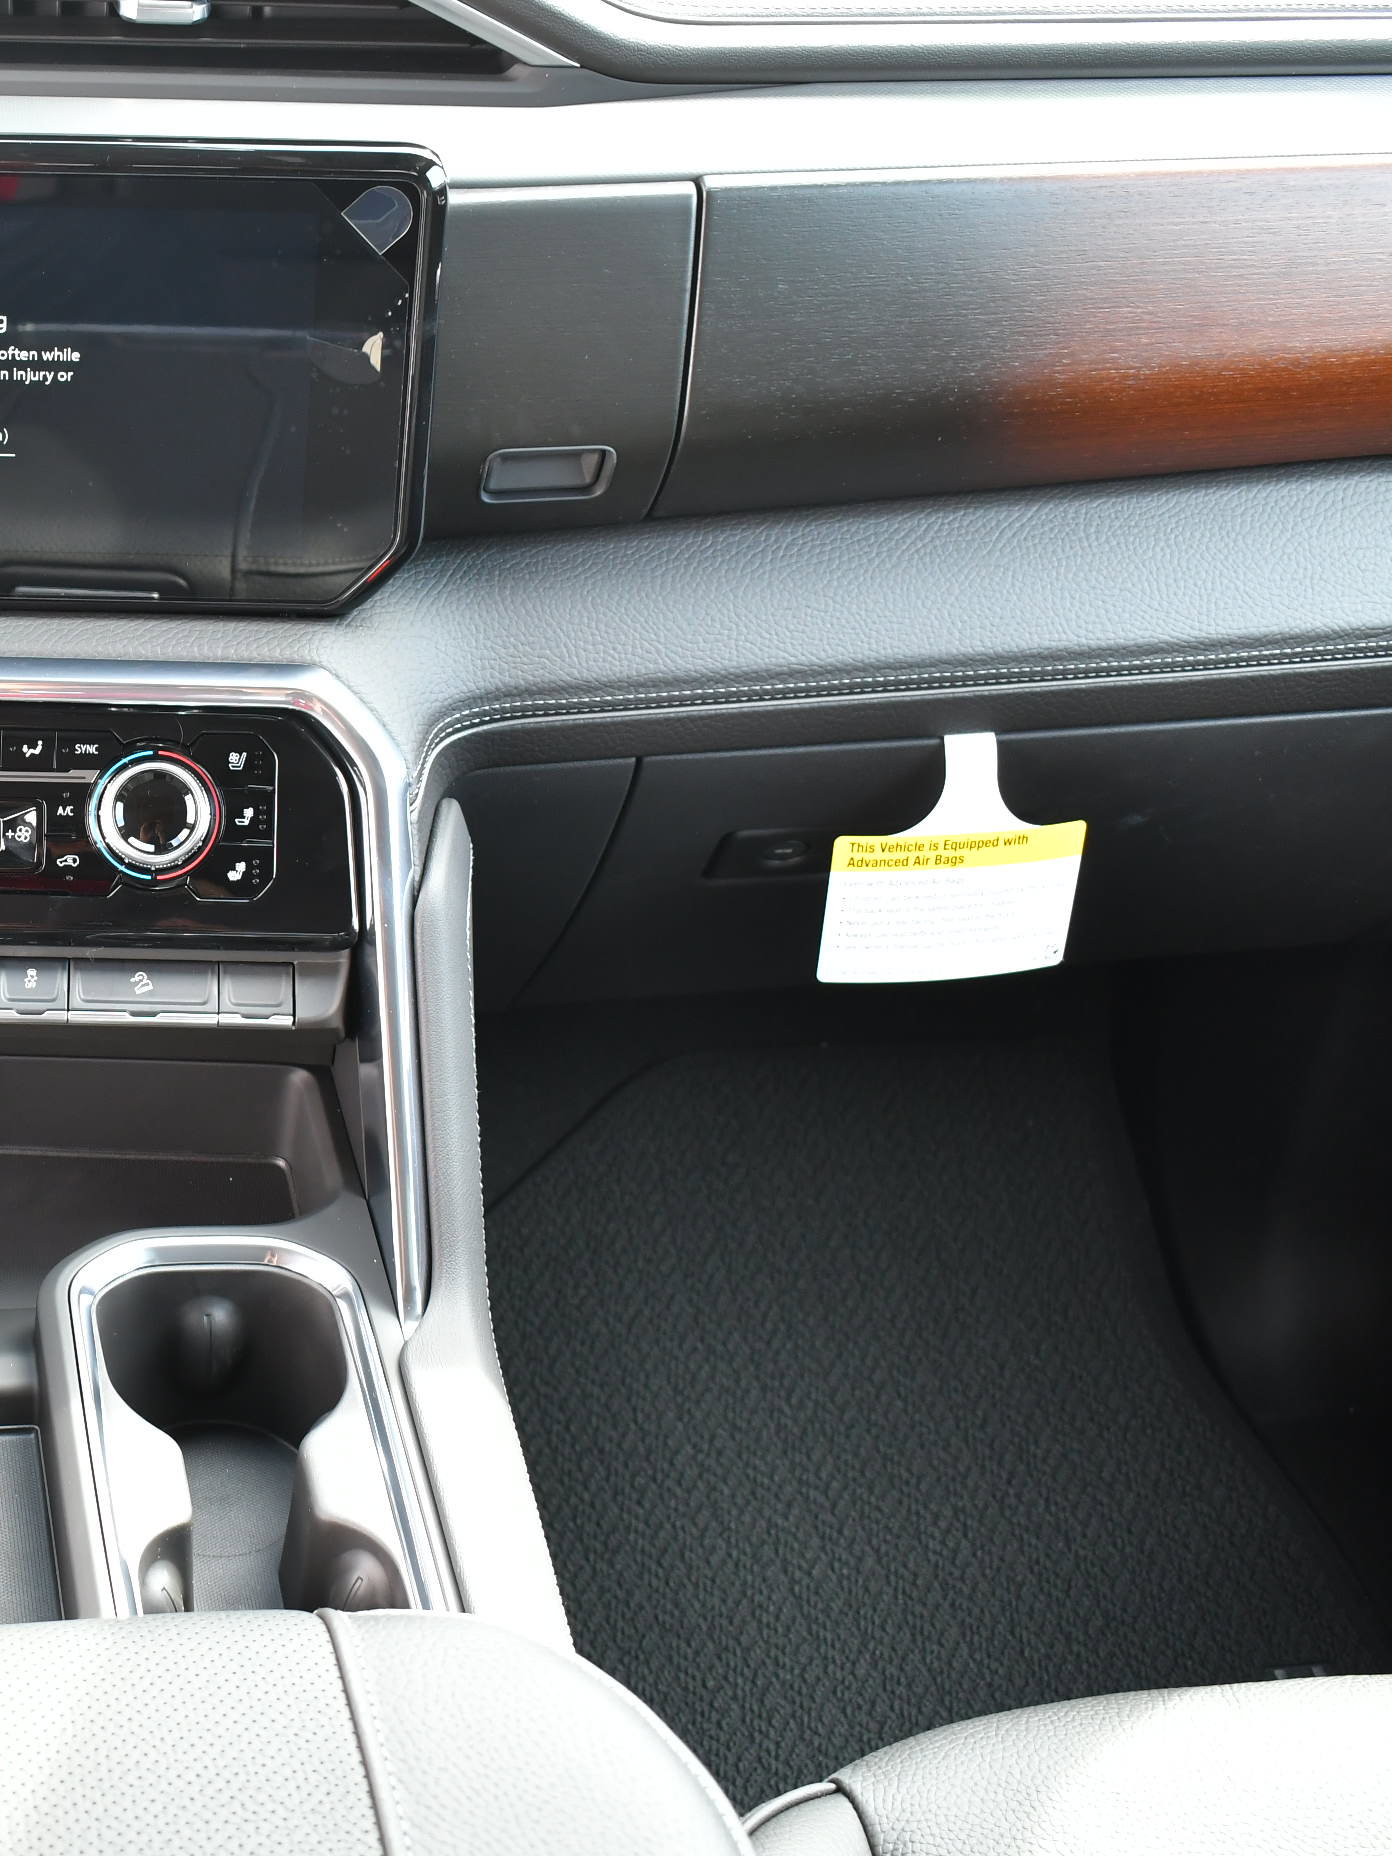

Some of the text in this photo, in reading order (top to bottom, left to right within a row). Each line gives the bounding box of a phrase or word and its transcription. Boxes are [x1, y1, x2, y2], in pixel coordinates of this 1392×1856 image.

[41, 347, 81, 362] while
[57, 370, 74, 382] or
[74, 744, 99, 755] SYNC
[57, 806, 74, 817] A/C
[849, 834, 1029, 854] This Vehicle is Equipped with
[847, 854, 965, 868] Advanced Air Bags
